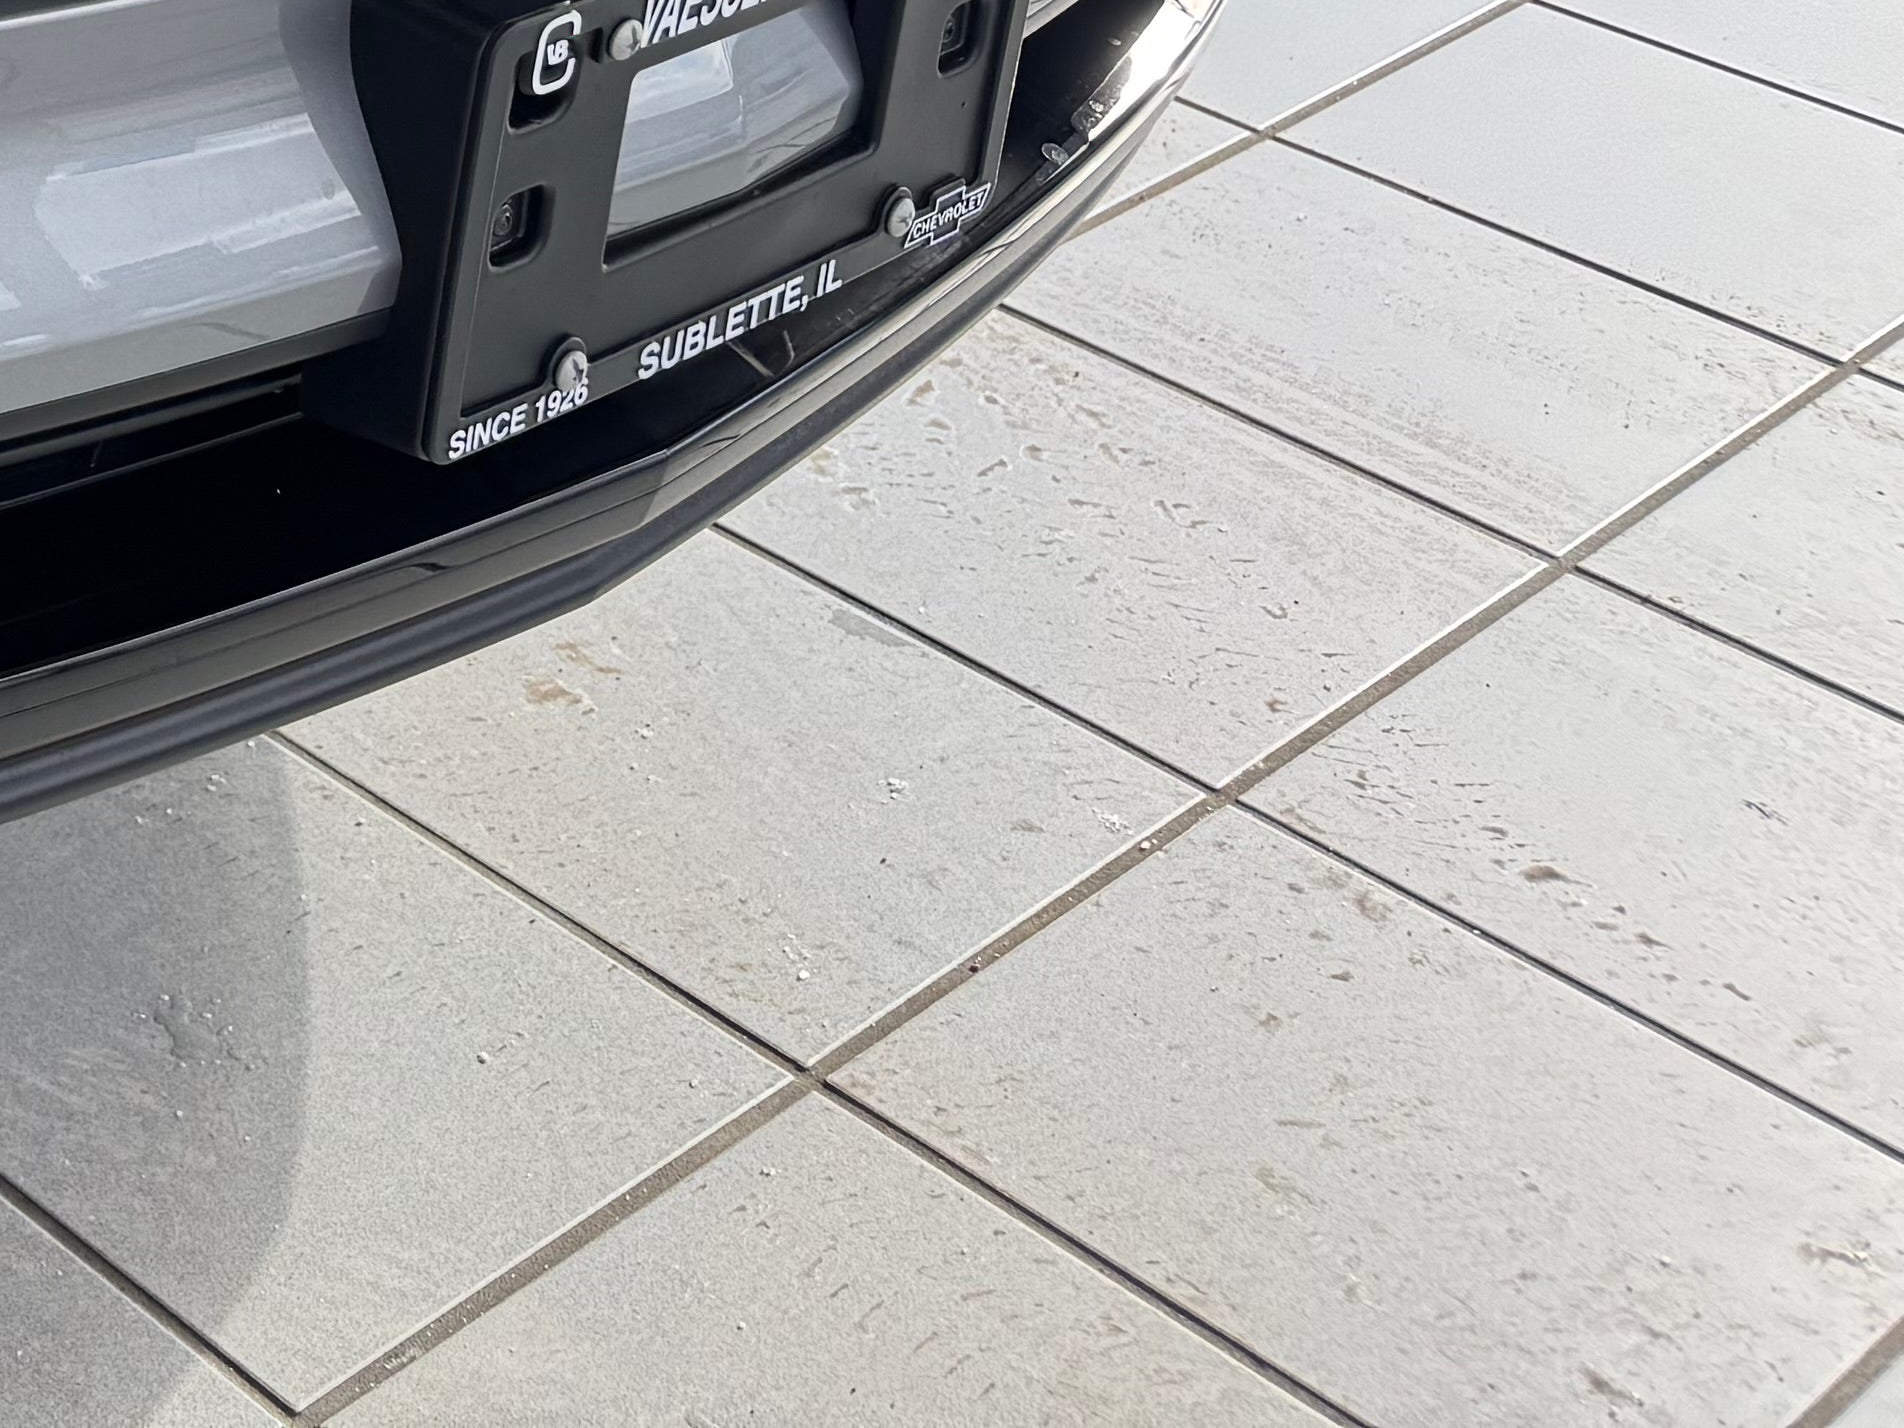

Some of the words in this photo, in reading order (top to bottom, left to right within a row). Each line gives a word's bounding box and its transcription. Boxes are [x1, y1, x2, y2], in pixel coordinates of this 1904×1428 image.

[913, 192, 984, 239] CHEVROLET
[638, 275, 809, 380] SUBLETTE,
[816, 259, 843, 298] IL
[448, 406, 526, 460] SINCE
[535, 378, 589, 422] 1926
